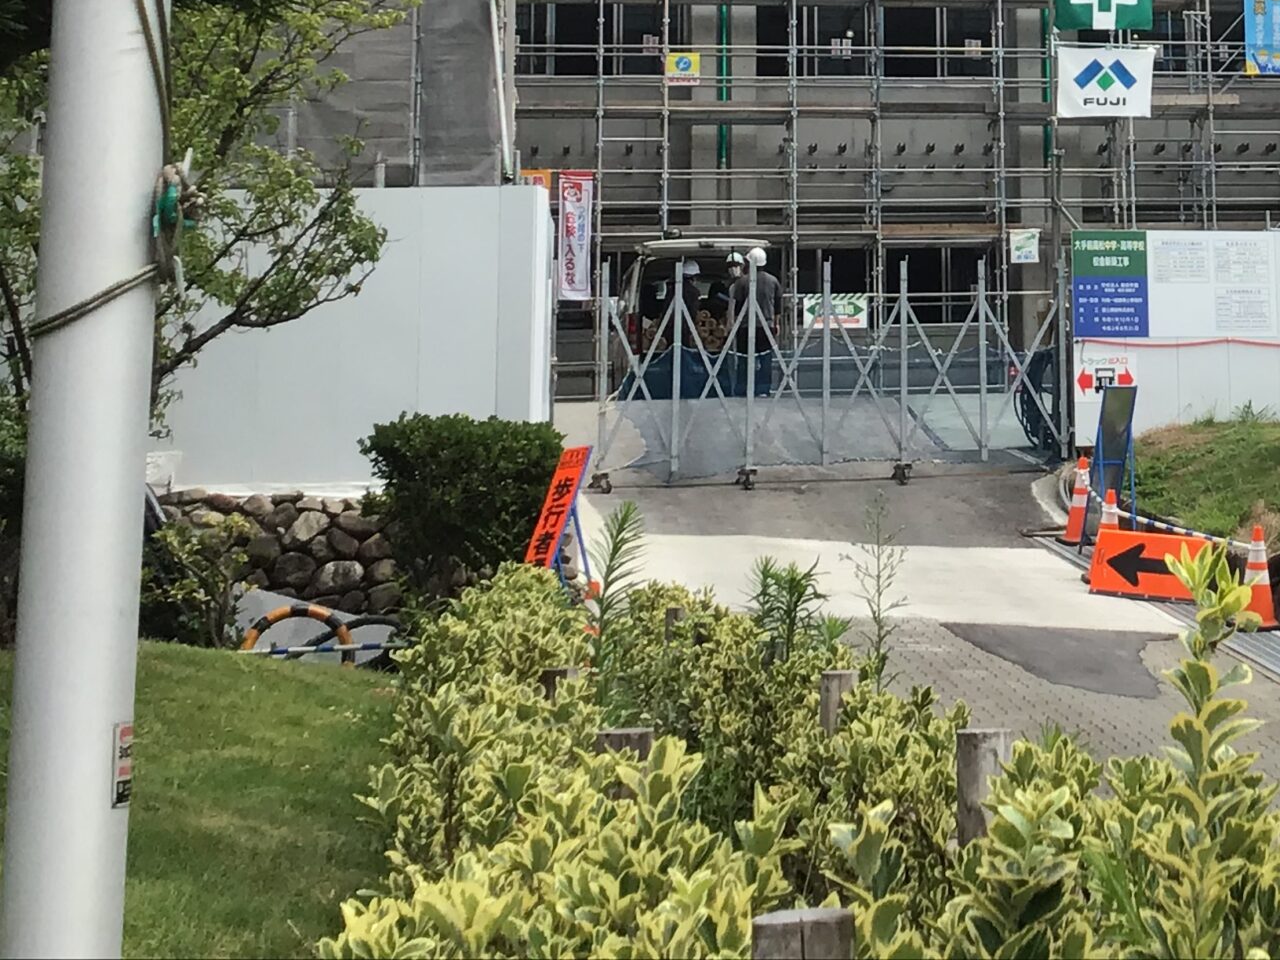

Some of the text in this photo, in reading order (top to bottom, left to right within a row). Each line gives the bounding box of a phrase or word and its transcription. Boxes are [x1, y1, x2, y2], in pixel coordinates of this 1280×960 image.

[1083, 97, 1127, 106] FUJI
[533, 476, 575, 567] 歩行者
